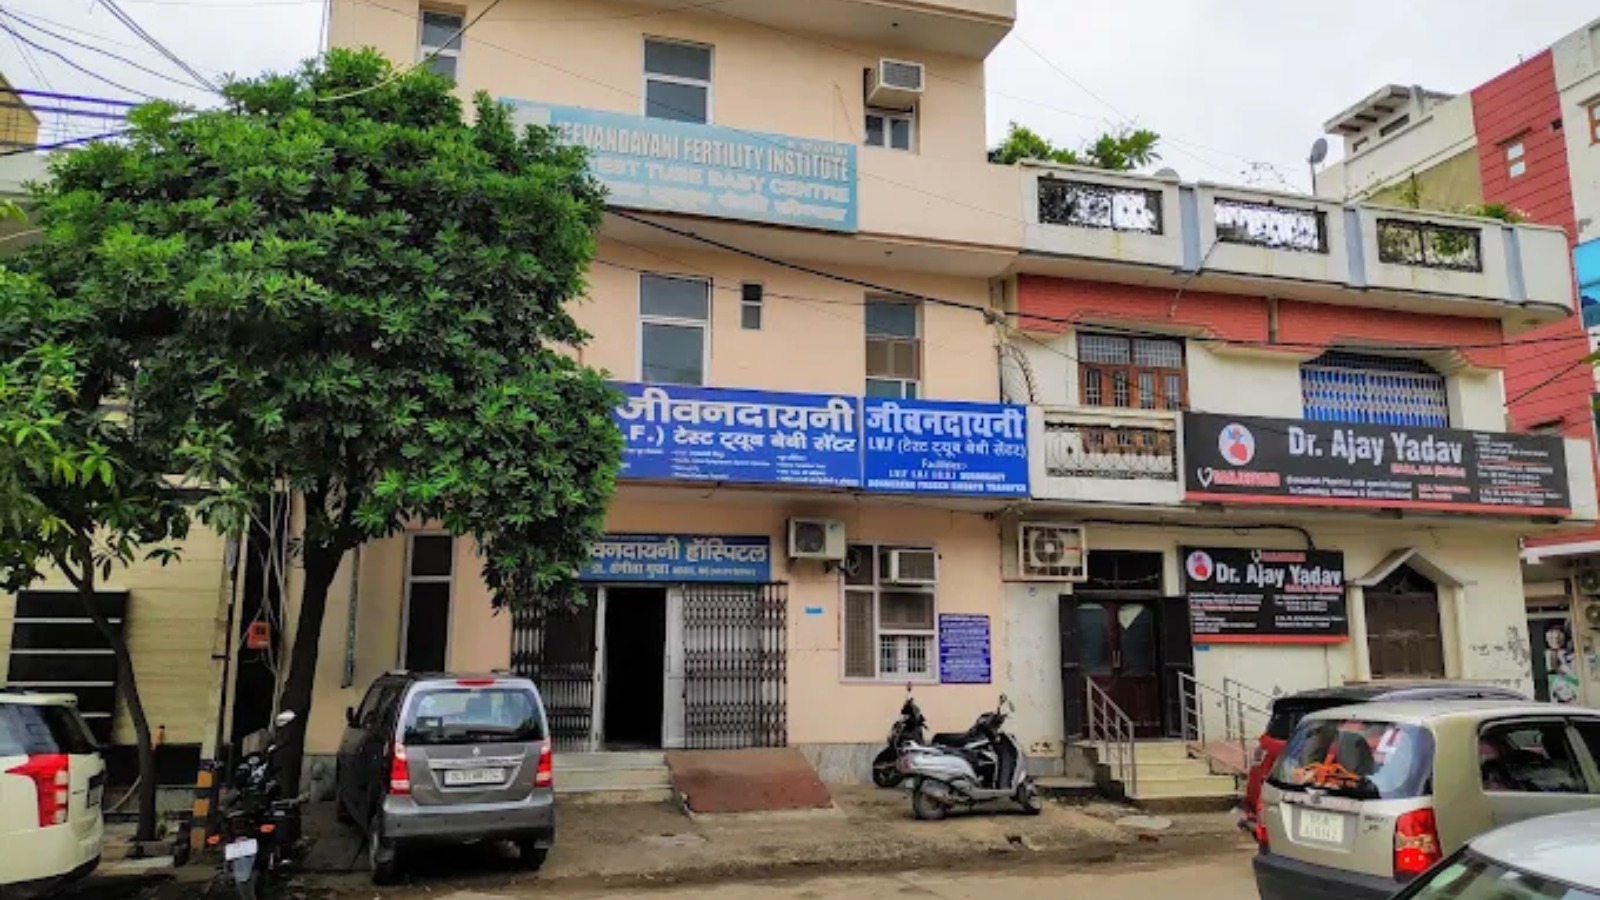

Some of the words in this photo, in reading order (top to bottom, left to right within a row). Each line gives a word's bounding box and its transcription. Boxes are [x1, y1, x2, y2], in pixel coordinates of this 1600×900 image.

[684, 136, 763, 170] FERTILITY
[768, 149, 848, 182] INSTITUTE
[615, 387, 856, 433] जीवनदायनी
[865, 401, 1025, 438] जीवनदायनी
[1288, 425, 1323, 457] Dr.
[1330, 429, 1384, 466] Ajay
[1390, 431, 1462, 463] Yadav
[588, 536, 680, 561] वनदायनी
[686, 537, 768, 563] हॉस्पिटल
[1215, 563, 1240, 584] Dr.
[1245, 563, 1285, 588] Ajay
[1289, 565, 1342, 586] Yadav
